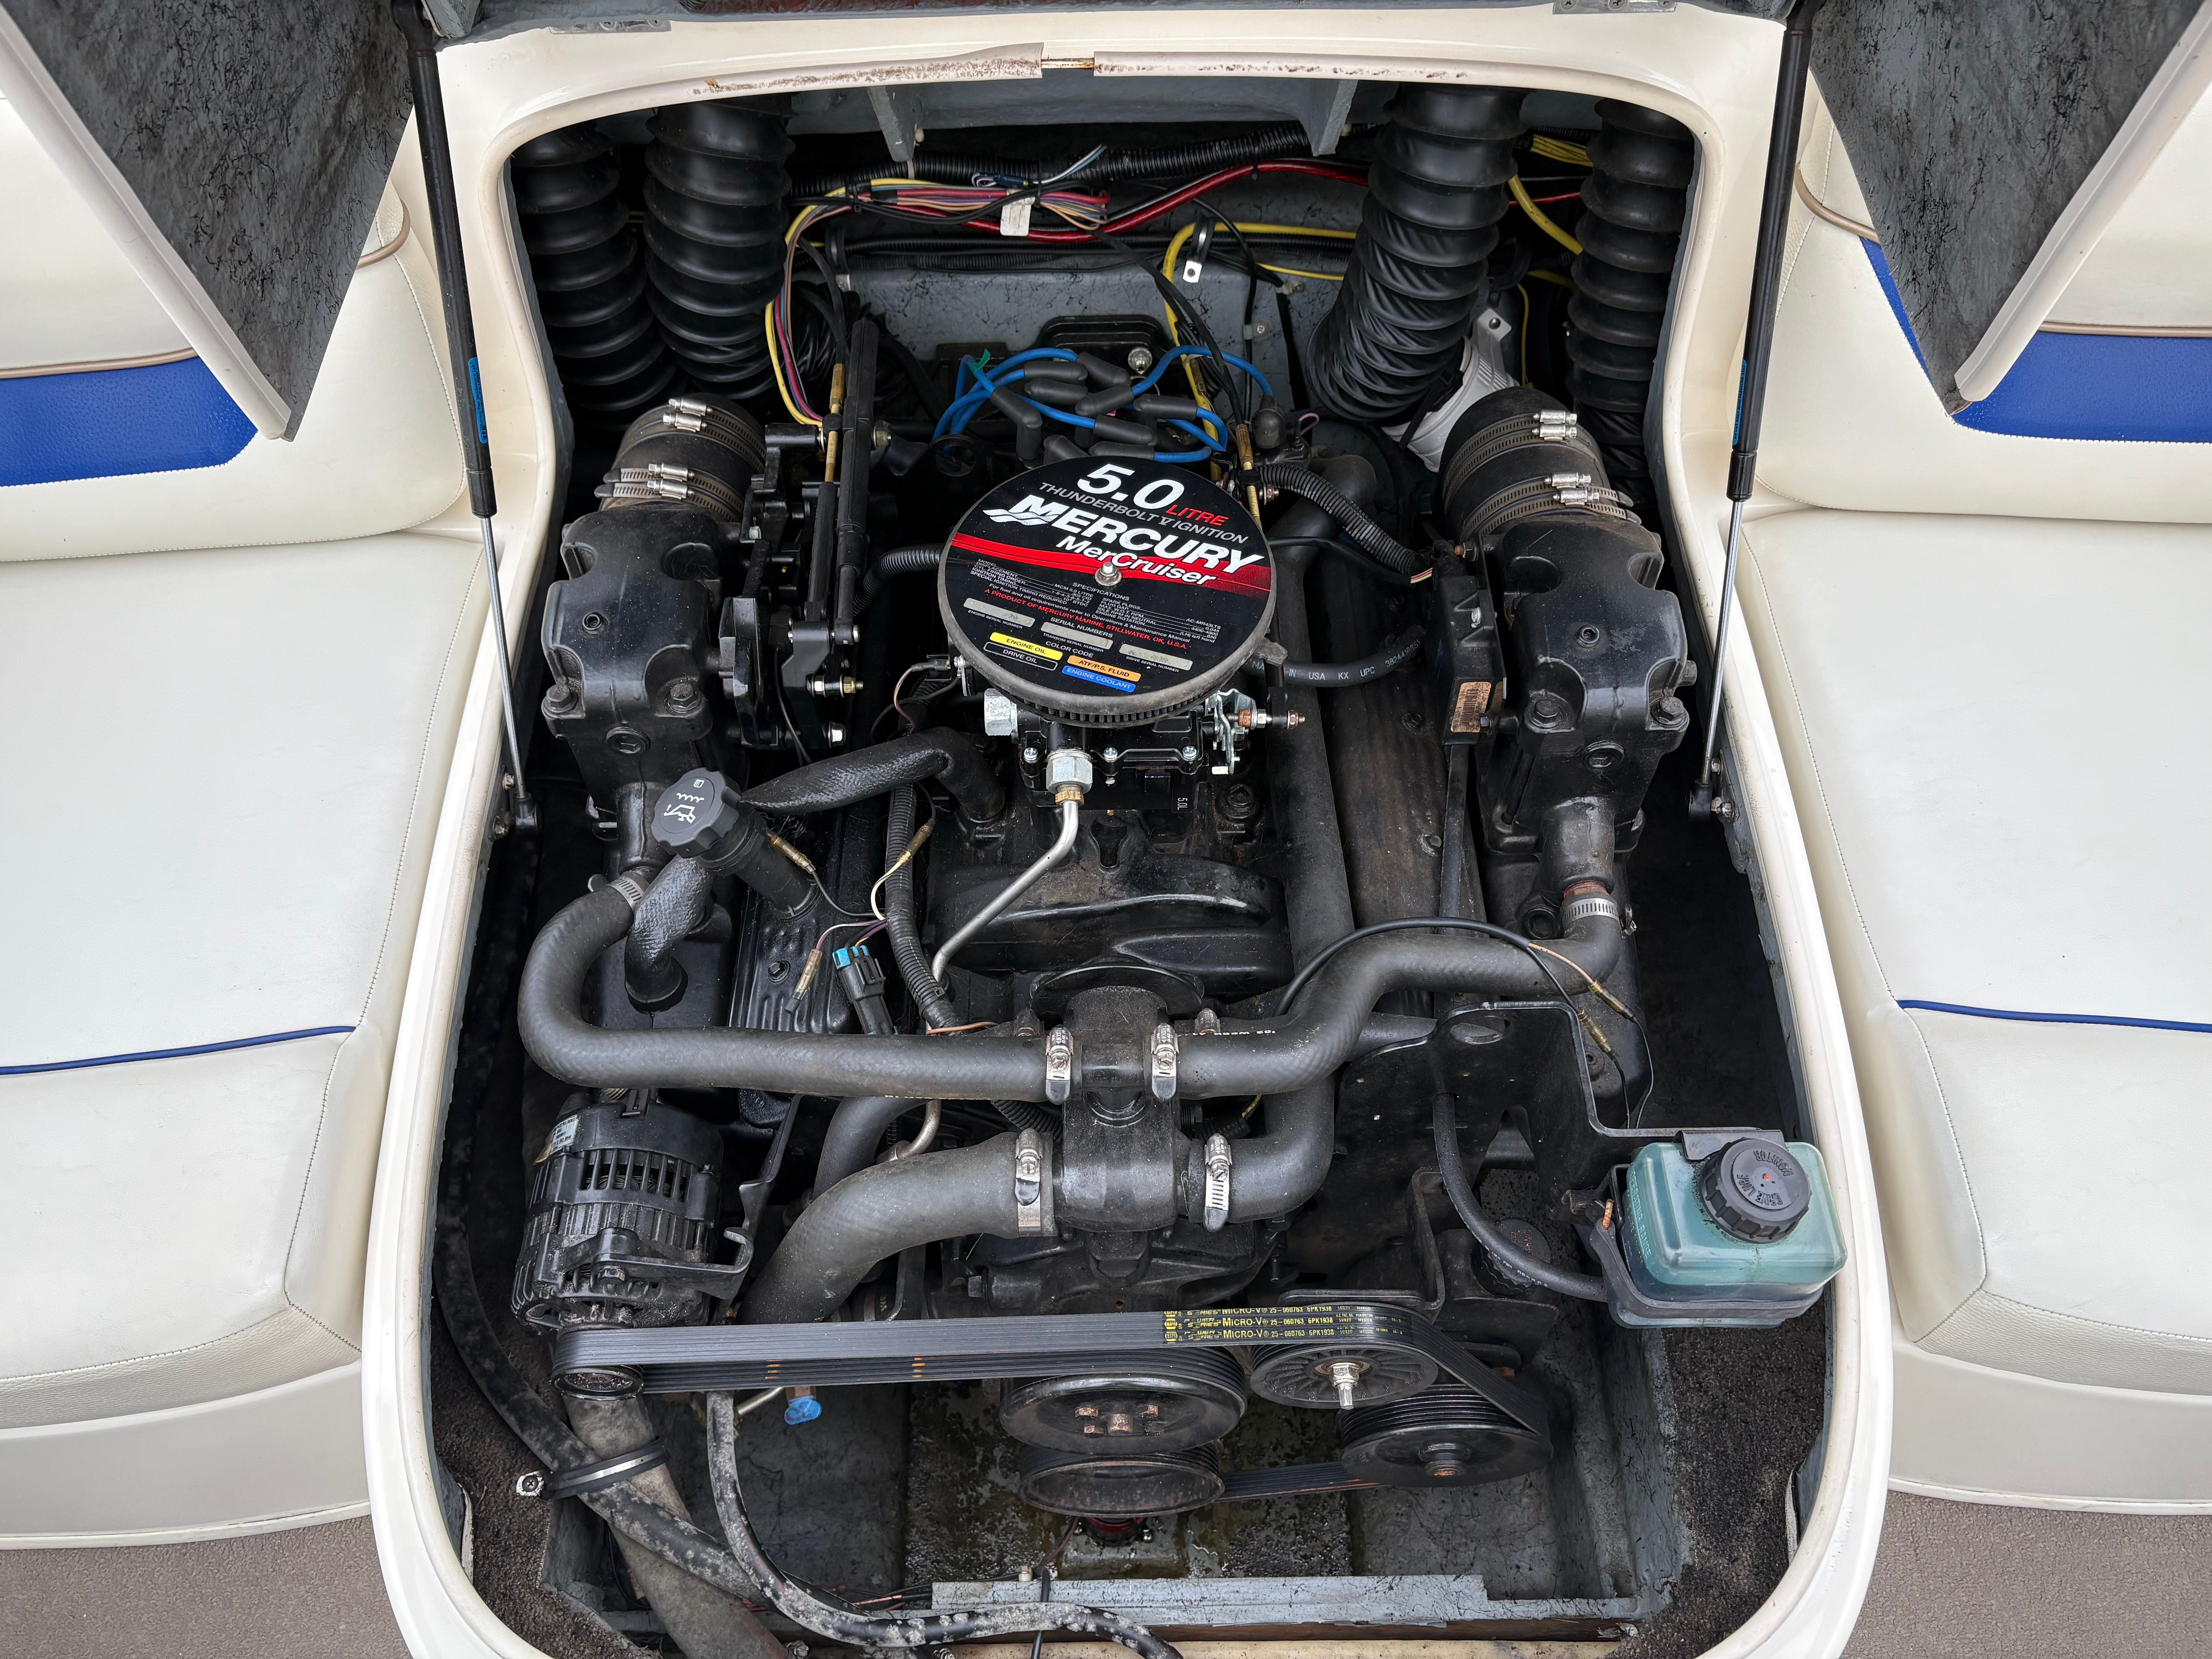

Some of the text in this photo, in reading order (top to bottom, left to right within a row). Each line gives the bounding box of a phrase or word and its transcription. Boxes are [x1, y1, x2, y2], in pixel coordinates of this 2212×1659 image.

[1077, 464, 1185, 509] 5.0
[1039, 482, 1162, 522] THUNDERBOLT
[1172, 522, 1249, 544] IGNITION
[1165, 504, 1229, 526] LITRE
[1007, 494, 1265, 574] MERCURY
[978, 559, 997, 567] MODEL
[1056, 535, 1217, 585] MerCruiser
[972, 567, 996, 580] IGNITION
[996, 576, 1017, 586] TIMING
[975, 562, 1018, 578] DISPLACEMENT
[987, 568, 1005, 577] FIRING
[1006, 575, 1026, 585] ORDER
[970, 570, 1068, 605] SPECIAL IGNITION TIMING REQUIRED
[1072, 582, 1130, 601] SPECIFICATIONS
[968, 610, 985, 618] ENGINE
[986, 615, 1001, 623] SERIAL
[1002, 620, 1023, 629] NUMBER
[991, 590, 1027, 605] PRODUCT
[1038, 605, 1074, 619] MERCURY
[1075, 616, 1104, 629] MARINE,
[1106, 624, 1151, 641] STILLWATER,
[1167, 639, 1187, 649] U.S.A.
[1032, 597, 1068, 612] requirements
[1092, 614, 1123, 626] Operations
[1129, 625, 1167, 637] Maintenance
[1168, 634, 1190, 643] Manual
[1095, 610, 1117, 620] ENGINE
[1118, 616, 1145, 626] ROTATION
[1114, 607, 1130, 616] W.O.T.
[1131, 616, 1156, 625] NEUTRAL
[1050, 617, 1113, 638] SERIAL NUMBERS
[1006, 638, 1034, 650] ENGINE
[1043, 632, 1066, 642] TRANSOM
[1083, 644, 1104, 653] NUMBER
[1046, 641, 1094, 658] COLOR CODE
[1003, 649, 1025, 659] DRIVE
[1079, 660, 1130, 677] ATF/P.S. FLUID
[1126, 656, 1140, 664] DRIVE
[1141, 659, 1157, 668] SERIAL
[1158, 664, 1179, 673] NUMBER
[1289, 669, 1296, 677] IN
[1309, 672, 1325, 680] USA
[1360, 666, 1375, 677] UPC
[1067, 668, 1132, 690] ENGINE COOLANT
[1177, 798, 1188, 810] 5.0L
[1753, 1150, 1794, 1176] MONITOR
[1737, 1174, 1757, 1196] LUBE
[1630, 1171, 1643, 1221] OPERATING
[1638, 1224, 1652, 1259] RANGE
